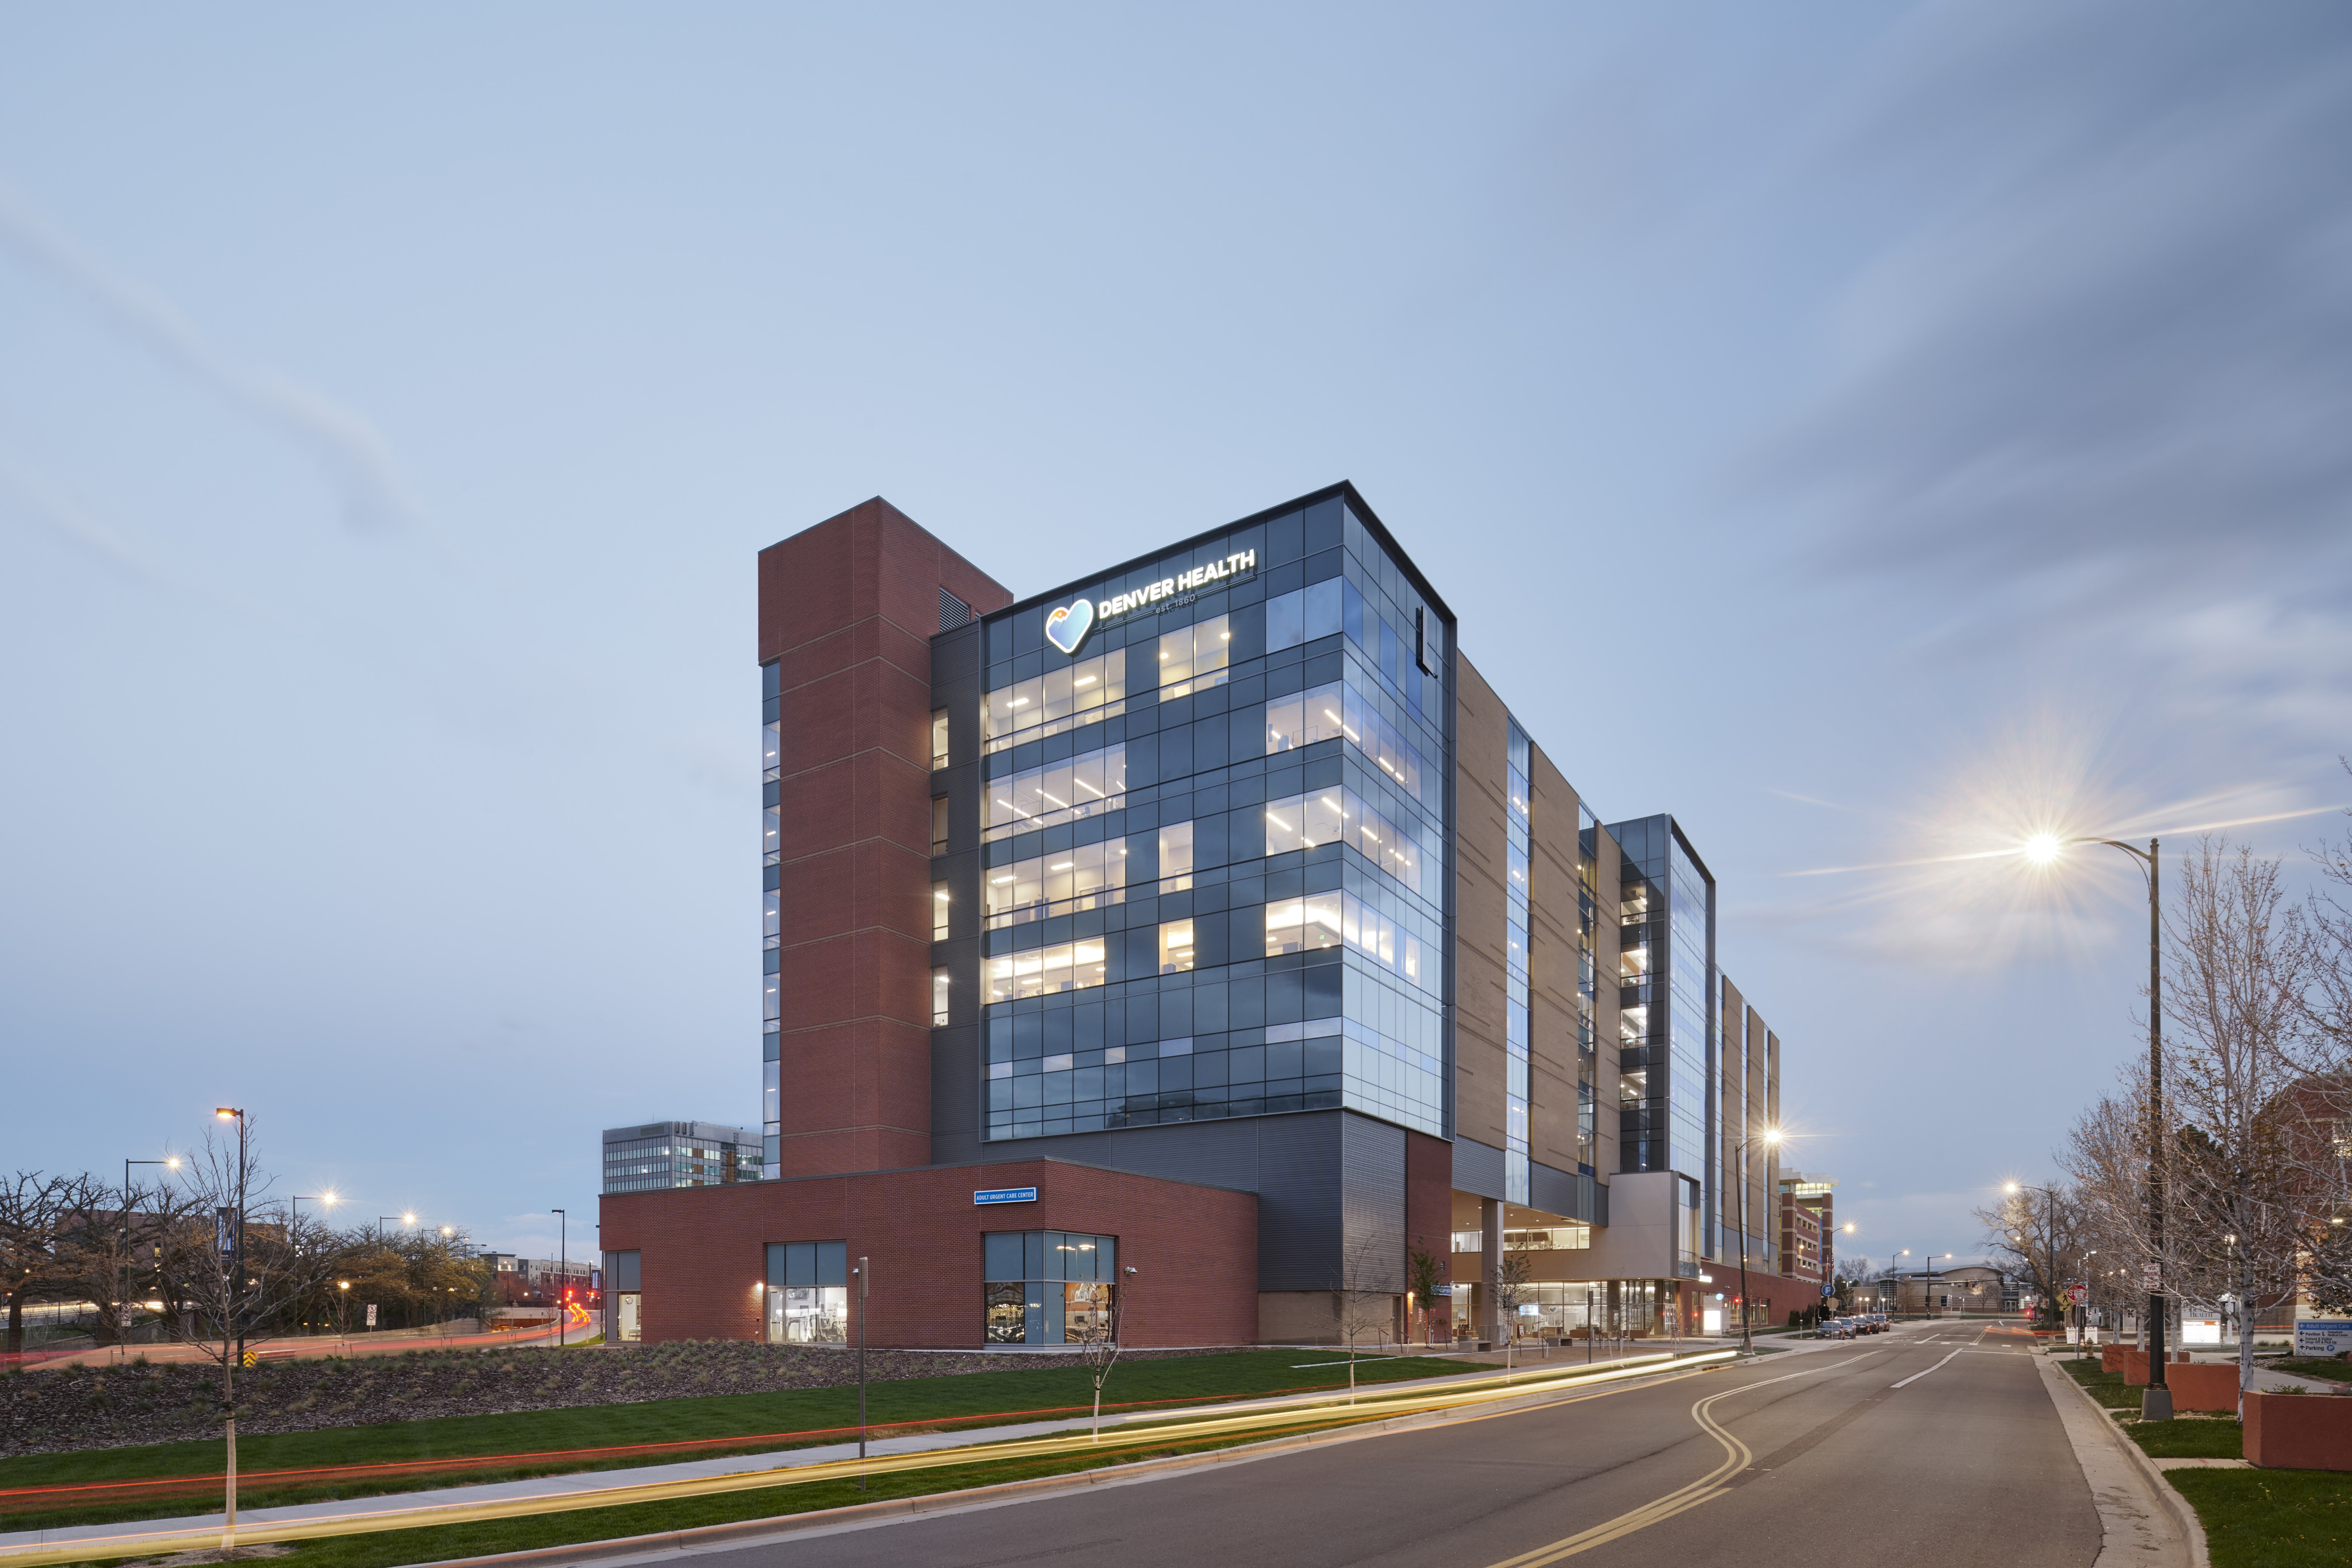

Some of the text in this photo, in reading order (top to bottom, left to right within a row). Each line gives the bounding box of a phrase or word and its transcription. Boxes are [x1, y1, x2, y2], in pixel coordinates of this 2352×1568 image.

[1099, 549, 1254, 619] DENVER HEALTH
[1156, 594, 1195, 614] est. 1860
